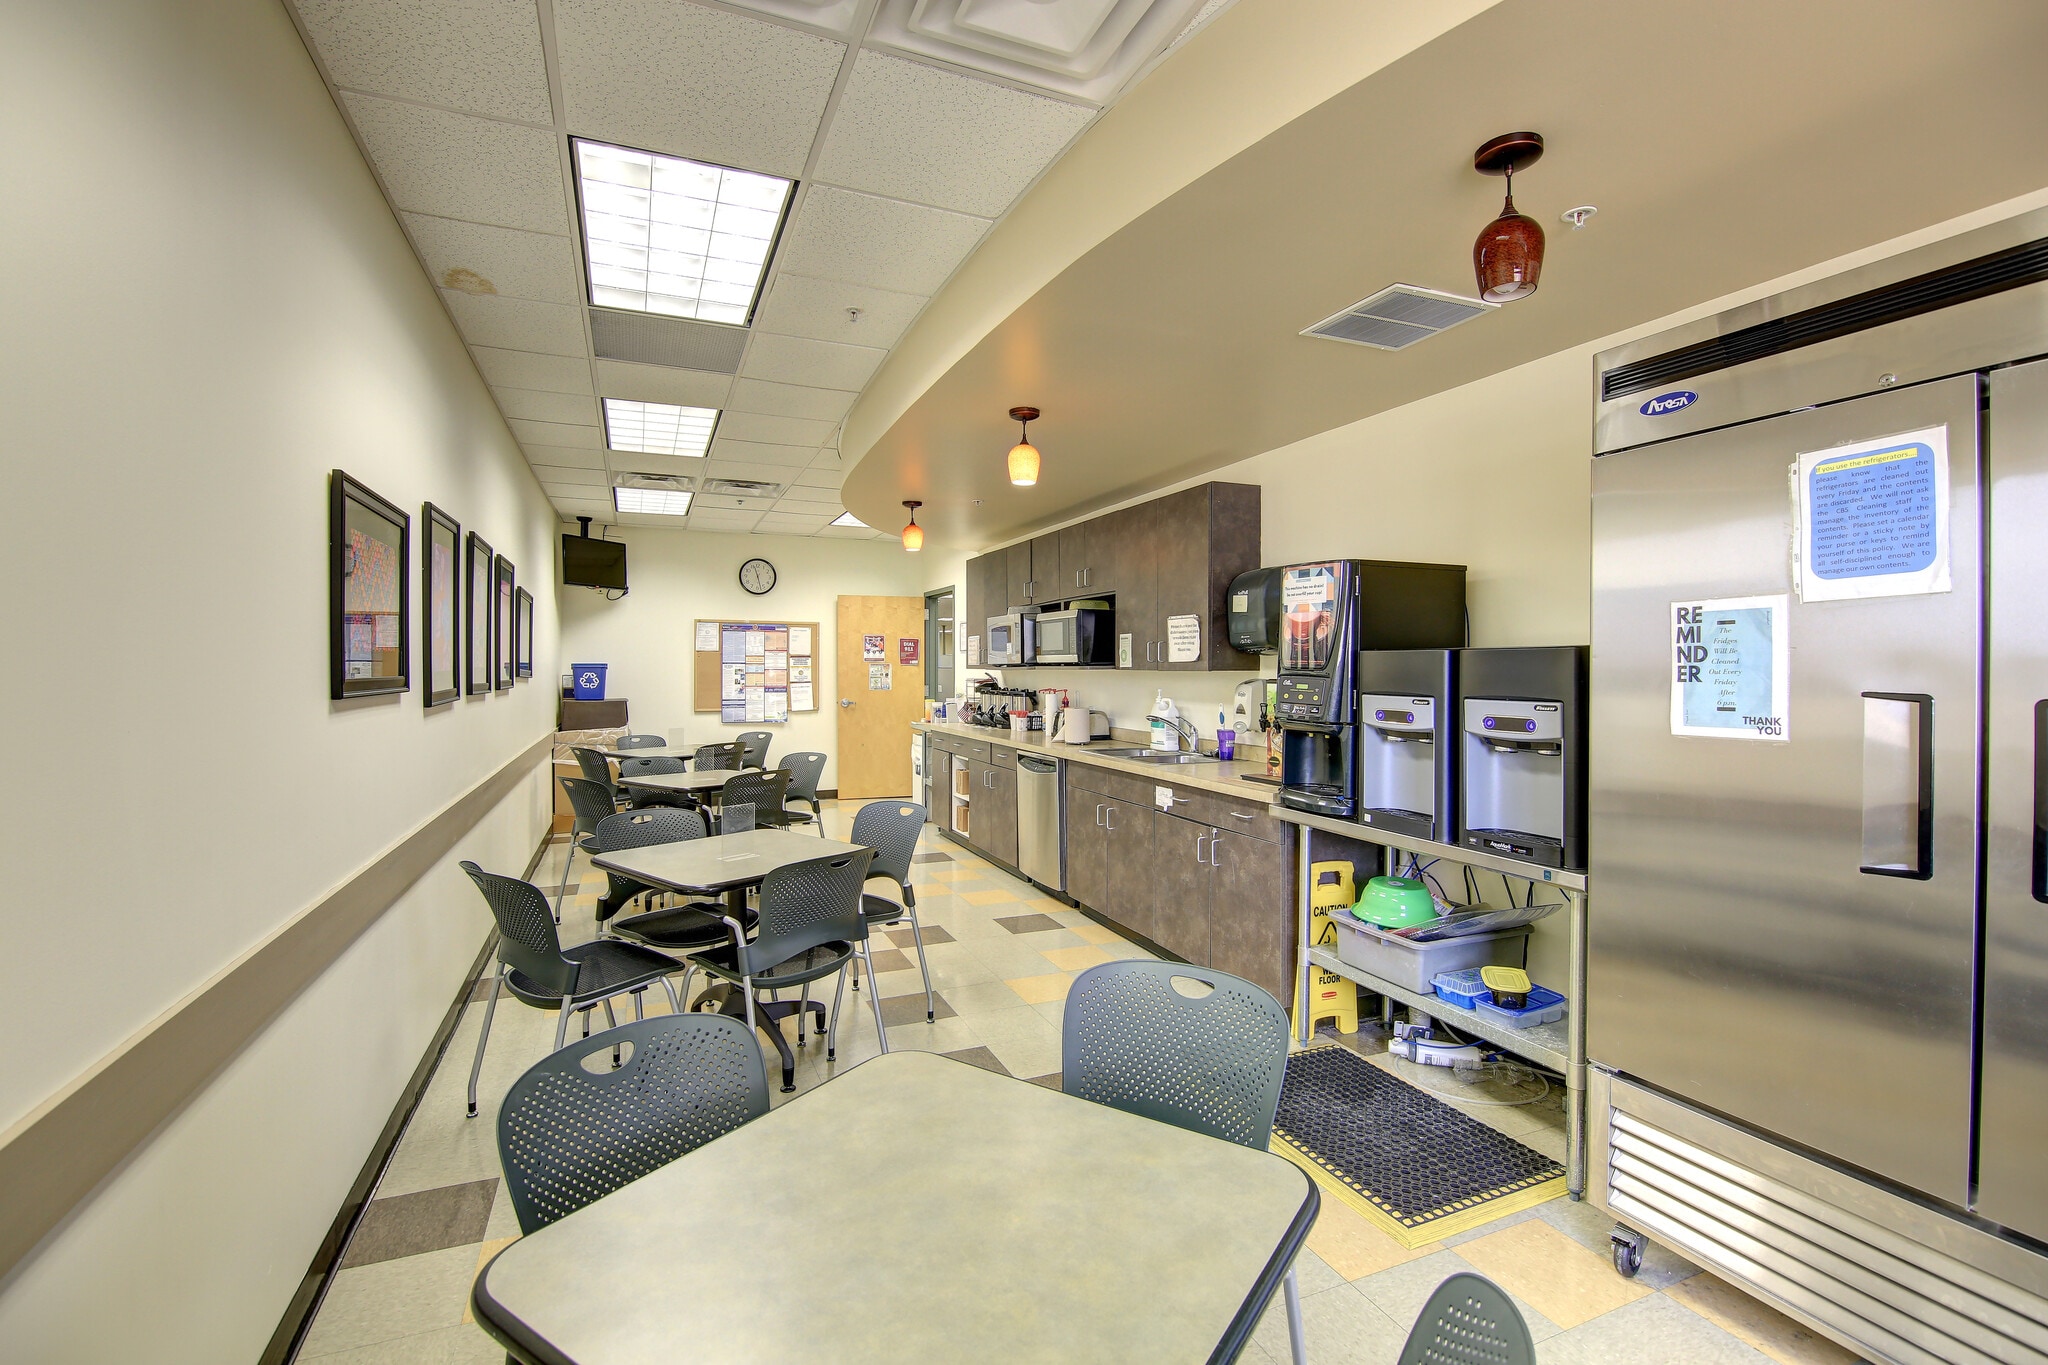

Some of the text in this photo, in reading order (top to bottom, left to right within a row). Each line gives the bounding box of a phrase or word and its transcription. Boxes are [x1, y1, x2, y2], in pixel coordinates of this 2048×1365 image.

[1816, 480, 1858, 492] refrigerators
[1881, 472, 1909, 481] cleaned
[1817, 492, 1835, 500] every
[1896, 478, 1928, 487] contents
[1857, 502, 1887, 511] Cleaning
[1864, 510, 1898, 518] inventory
[1897, 514, 1929, 523] calendar
[1831, 555, 1882, 565] self-disciplined
[1888, 551, 1915, 560] enough
[1677, 606, 1702, 624] RE
[1676, 626, 1701, 643] MI
[1677, 646, 1708, 663] ND
[1677, 665, 1702, 682] ER
[1714, 678, 1737, 686] Friday
[1742, 716, 1781, 726] THANK
[1757, 726, 1781, 735] YOU
[1319, 976, 1340, 985] FLOOR
